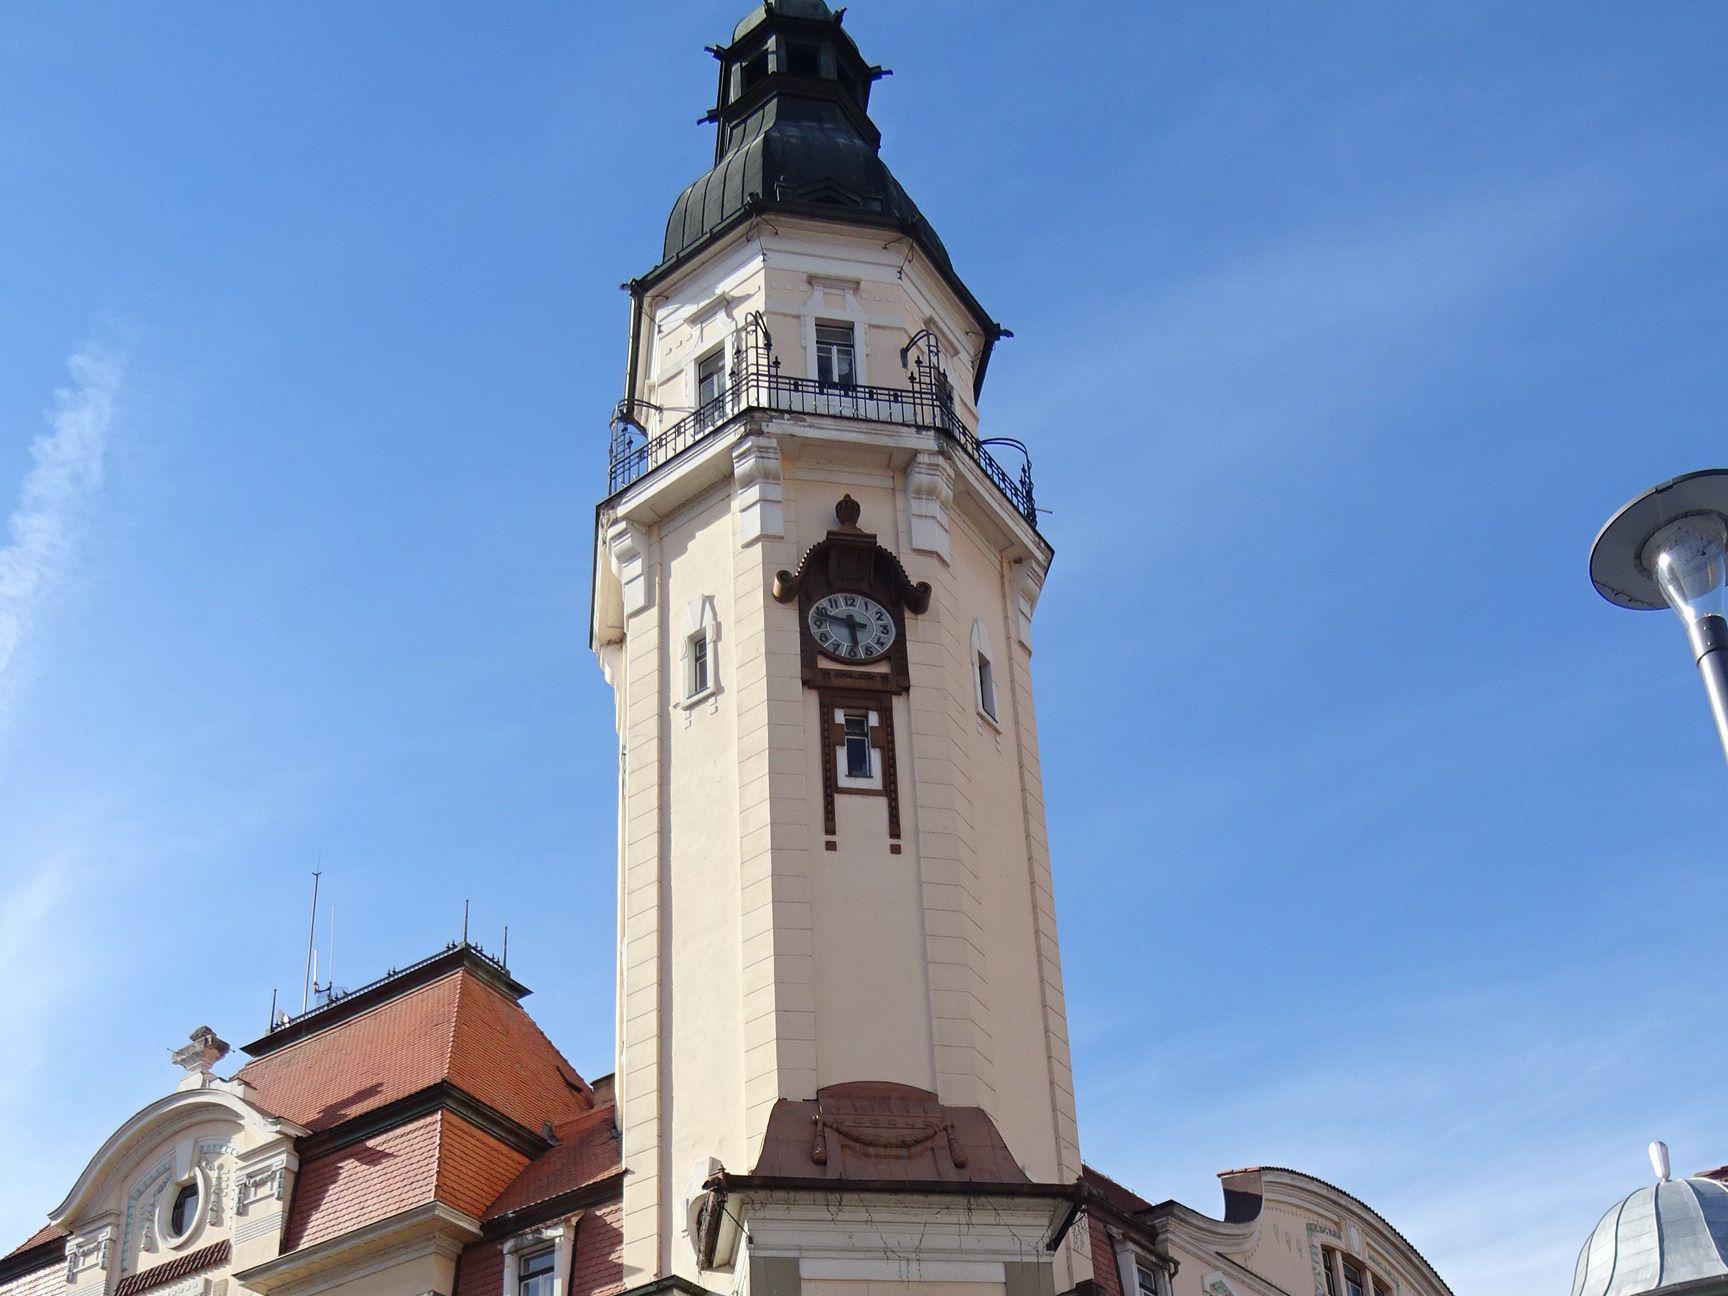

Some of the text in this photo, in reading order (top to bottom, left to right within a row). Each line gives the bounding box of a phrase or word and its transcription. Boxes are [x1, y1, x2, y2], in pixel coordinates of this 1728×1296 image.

[828, 598, 839, 609] 11
[844, 596, 856, 607] 12
[864, 602, 869, 611] 1
[875, 611, 884, 621] 2
[814, 619, 822, 629] 9
[880, 624, 890, 635] 3
[819, 632, 828, 642] 8
[876, 638, 885, 647] 4
[831, 642, 841, 654] 7
[848, 646, 857, 658] 6
[865, 646, 874, 656] 5
